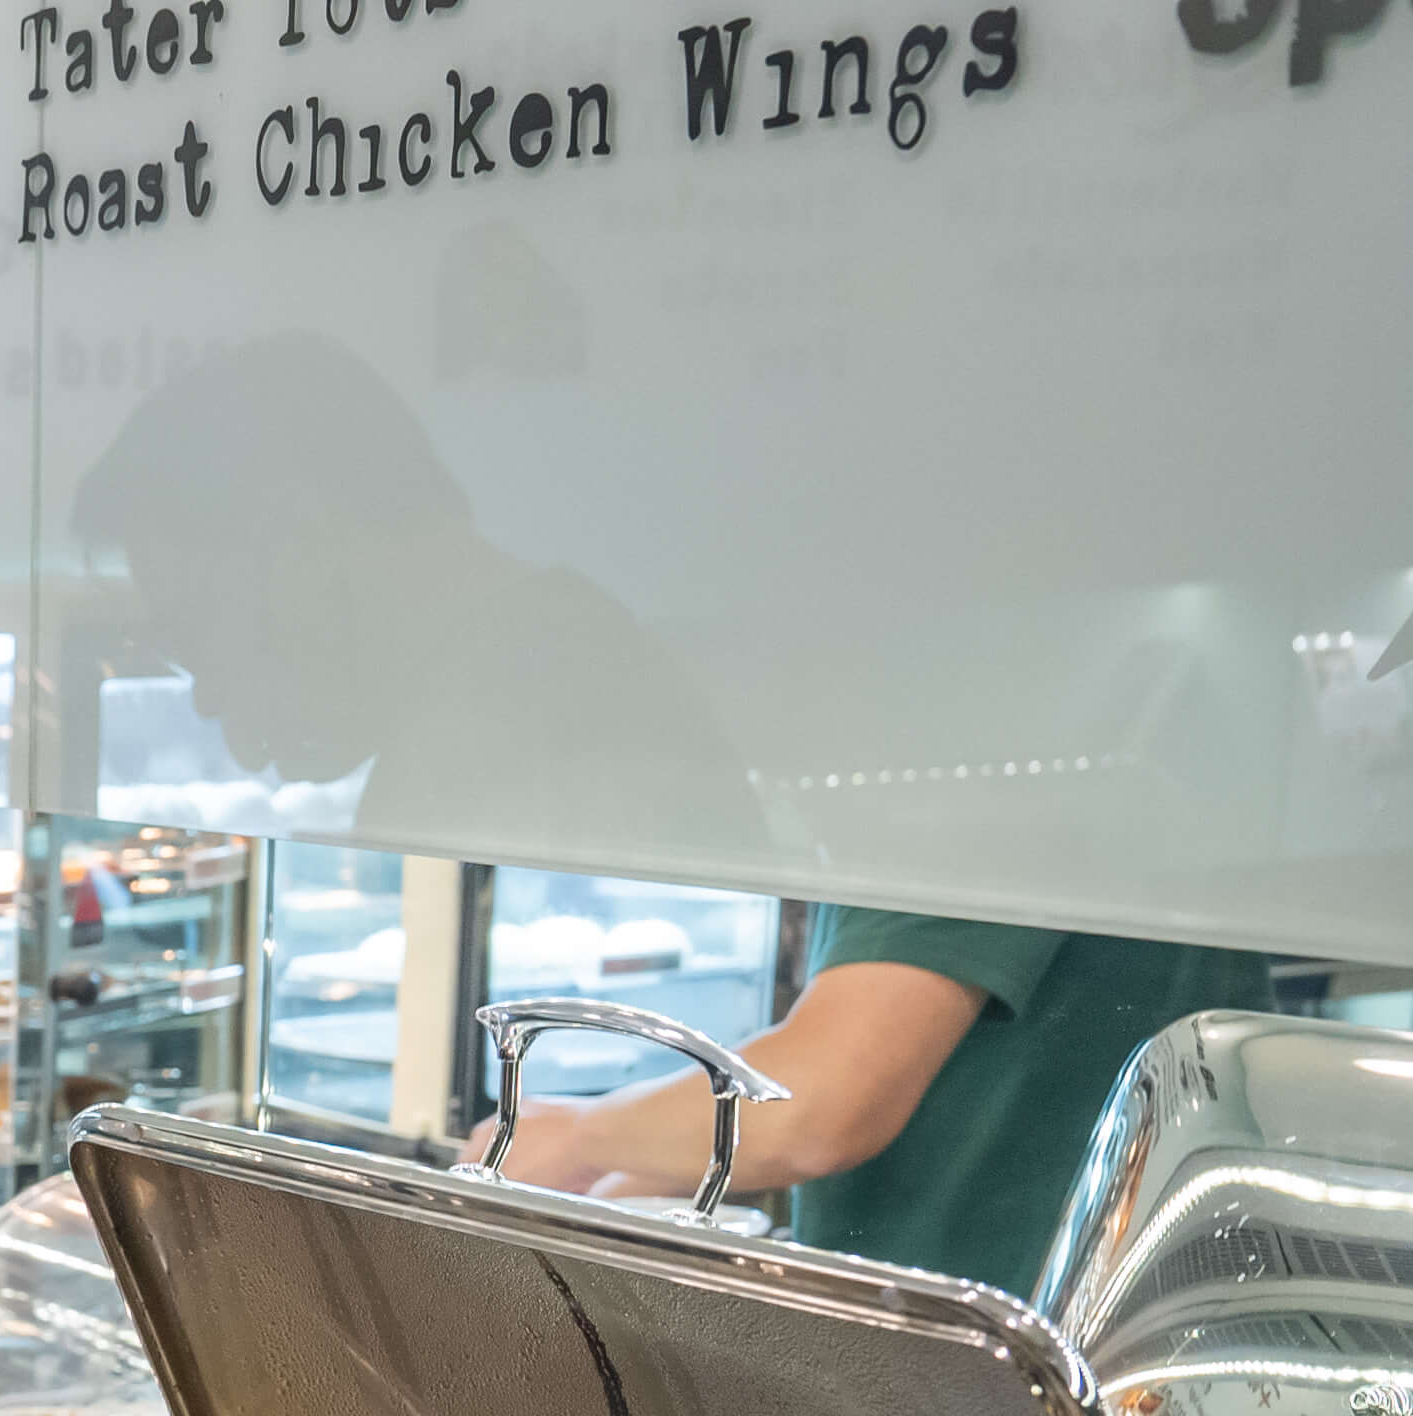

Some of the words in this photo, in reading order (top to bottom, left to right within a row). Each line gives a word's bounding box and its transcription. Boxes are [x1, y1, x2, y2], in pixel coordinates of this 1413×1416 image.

[18, 120, 213, 243] Roast
[255, 69, 614, 206] Chicken
[677, 6, 1023, 150] Wings
[20, 0, 225, 102] Tater
